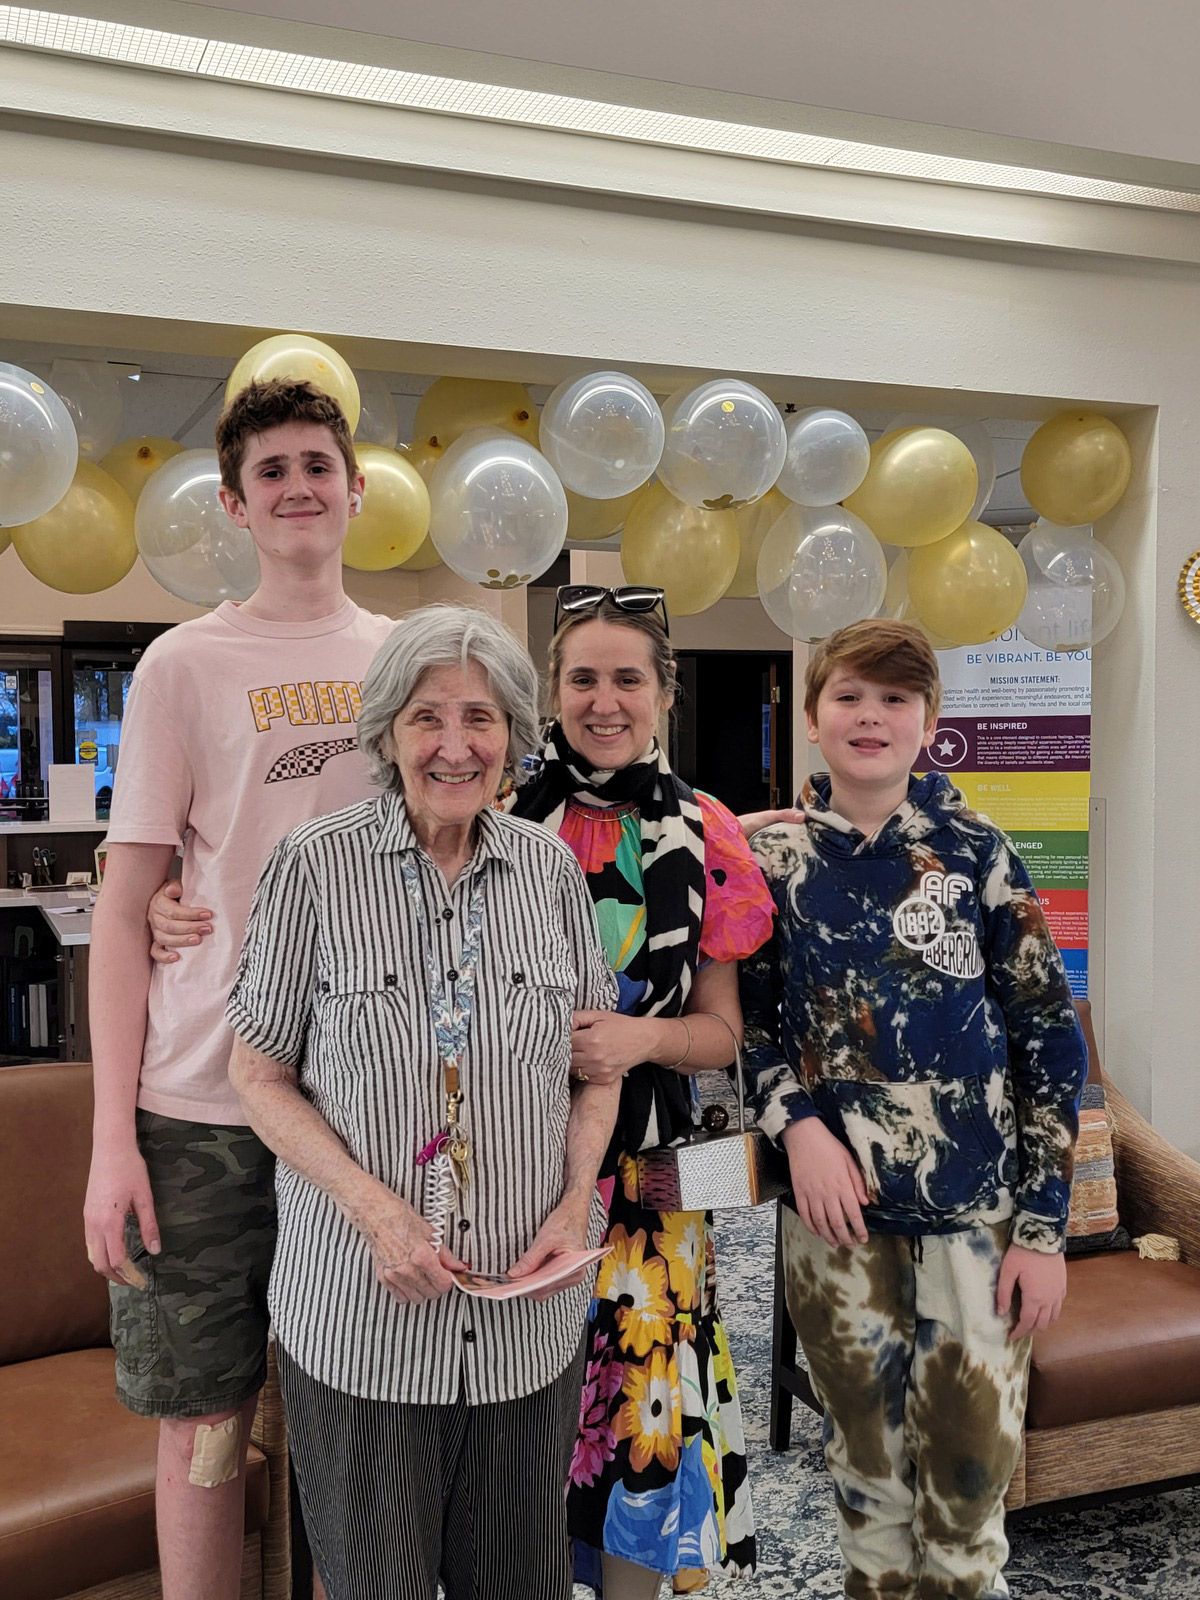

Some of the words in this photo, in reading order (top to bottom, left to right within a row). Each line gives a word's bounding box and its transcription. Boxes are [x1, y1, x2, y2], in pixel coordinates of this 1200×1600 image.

[967, 654, 982, 664] BE
[986, 652, 1042, 663] VIBRANT.
[1046, 652, 1062, 662] BE
[1020, 676, 1060, 684] STATEMENT:
[899, 911, 940, 936] 1892
